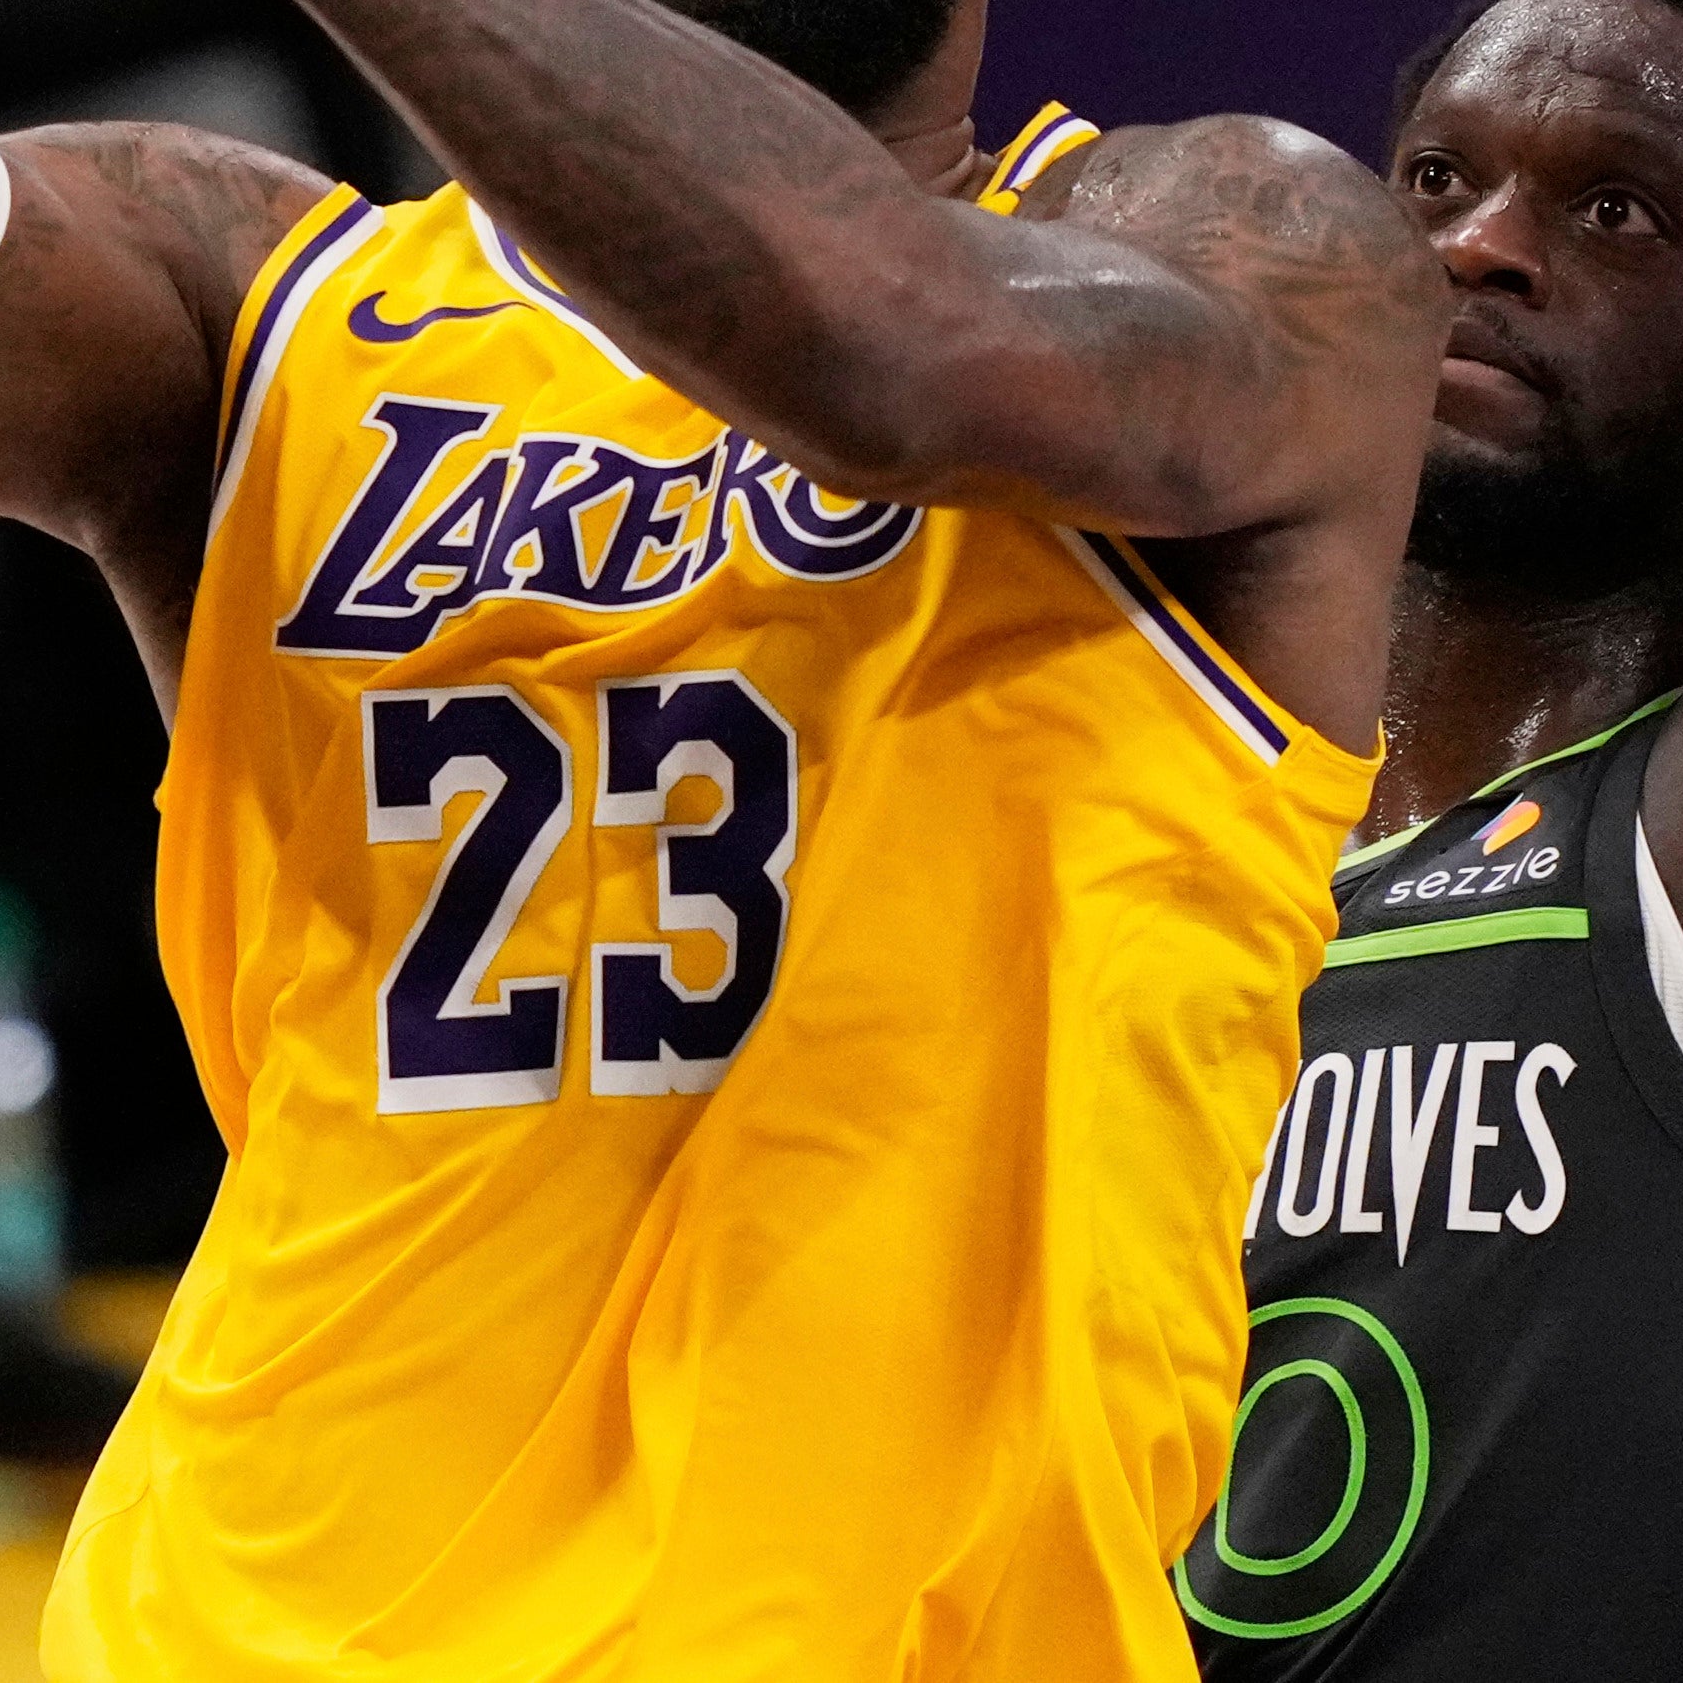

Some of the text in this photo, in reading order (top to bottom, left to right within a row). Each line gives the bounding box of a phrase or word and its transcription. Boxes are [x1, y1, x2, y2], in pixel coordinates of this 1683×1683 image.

[361, 667, 798, 1116] 23
[1384, 847, 1560, 904] sezzle
[1242, 1040, 1577, 1268] OLVES
